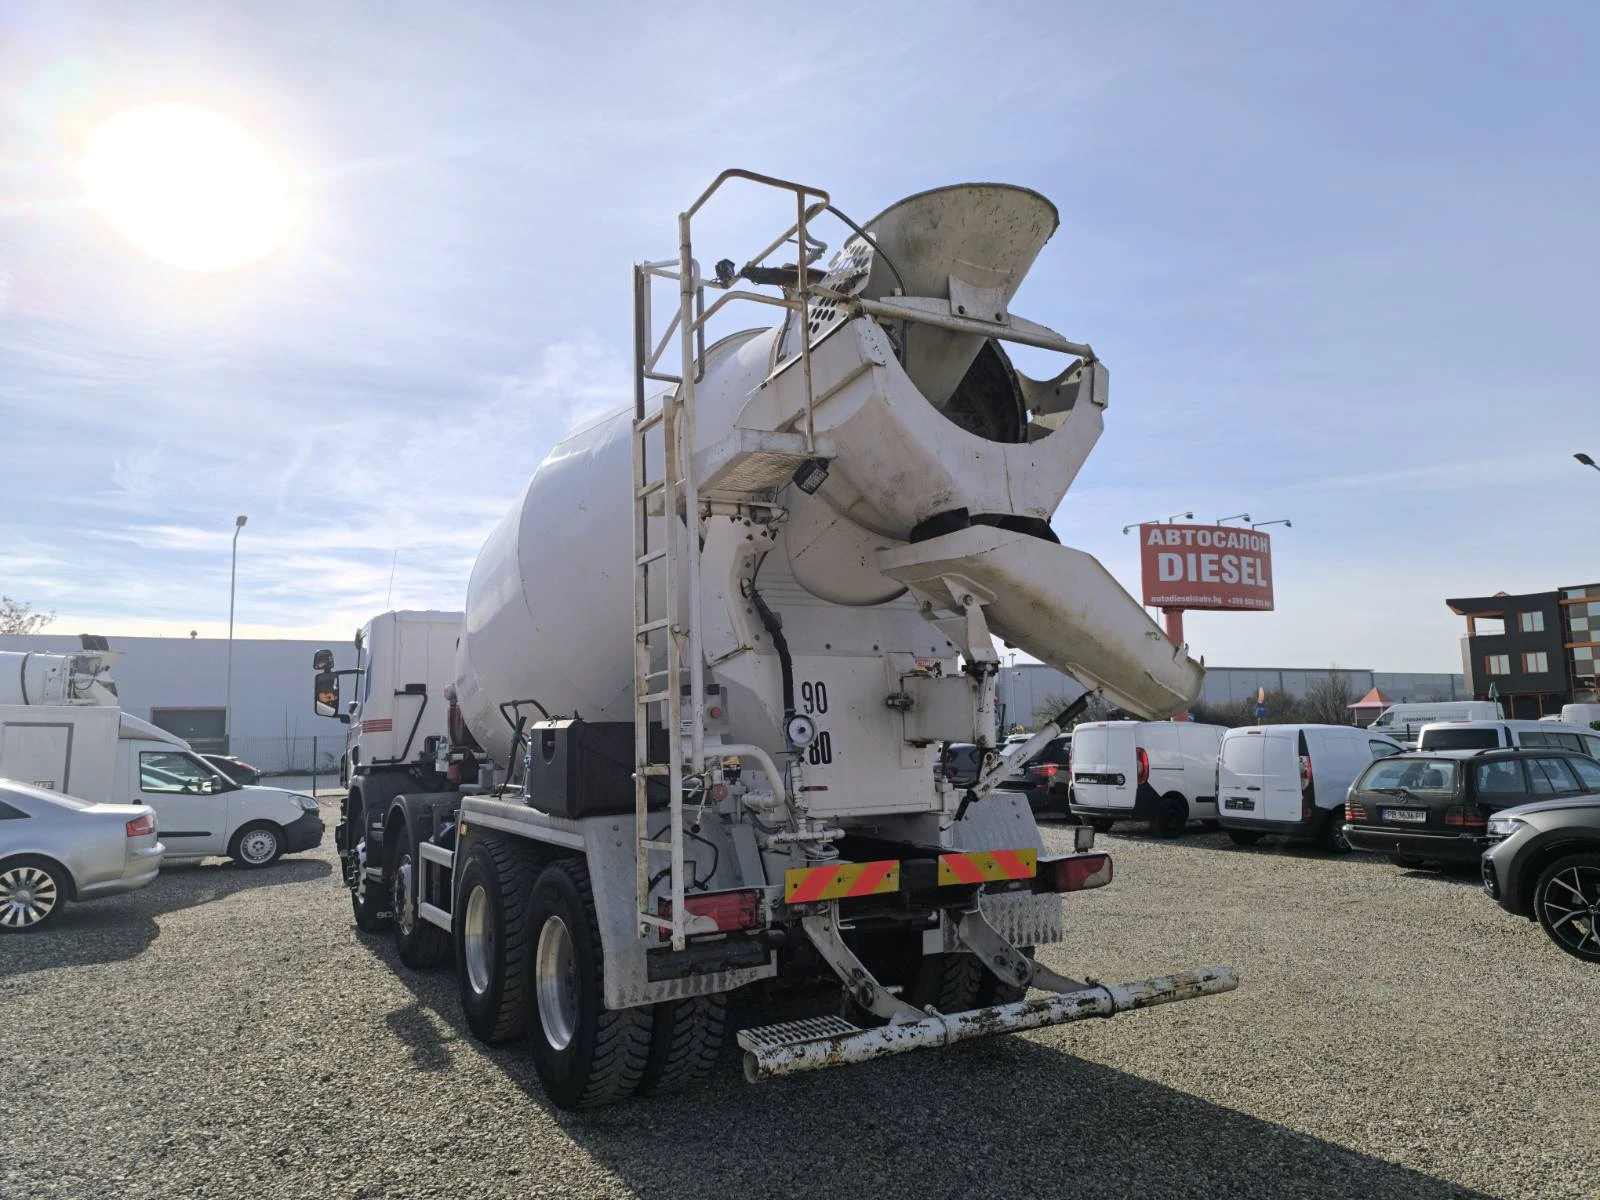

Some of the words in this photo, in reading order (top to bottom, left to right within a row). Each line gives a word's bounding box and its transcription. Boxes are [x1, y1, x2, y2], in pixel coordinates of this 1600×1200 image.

[1147, 528, 1268, 553] АВТОСАЛОН
[1158, 552, 1267, 587] DIESEL
[801, 681, 828, 714] 90
